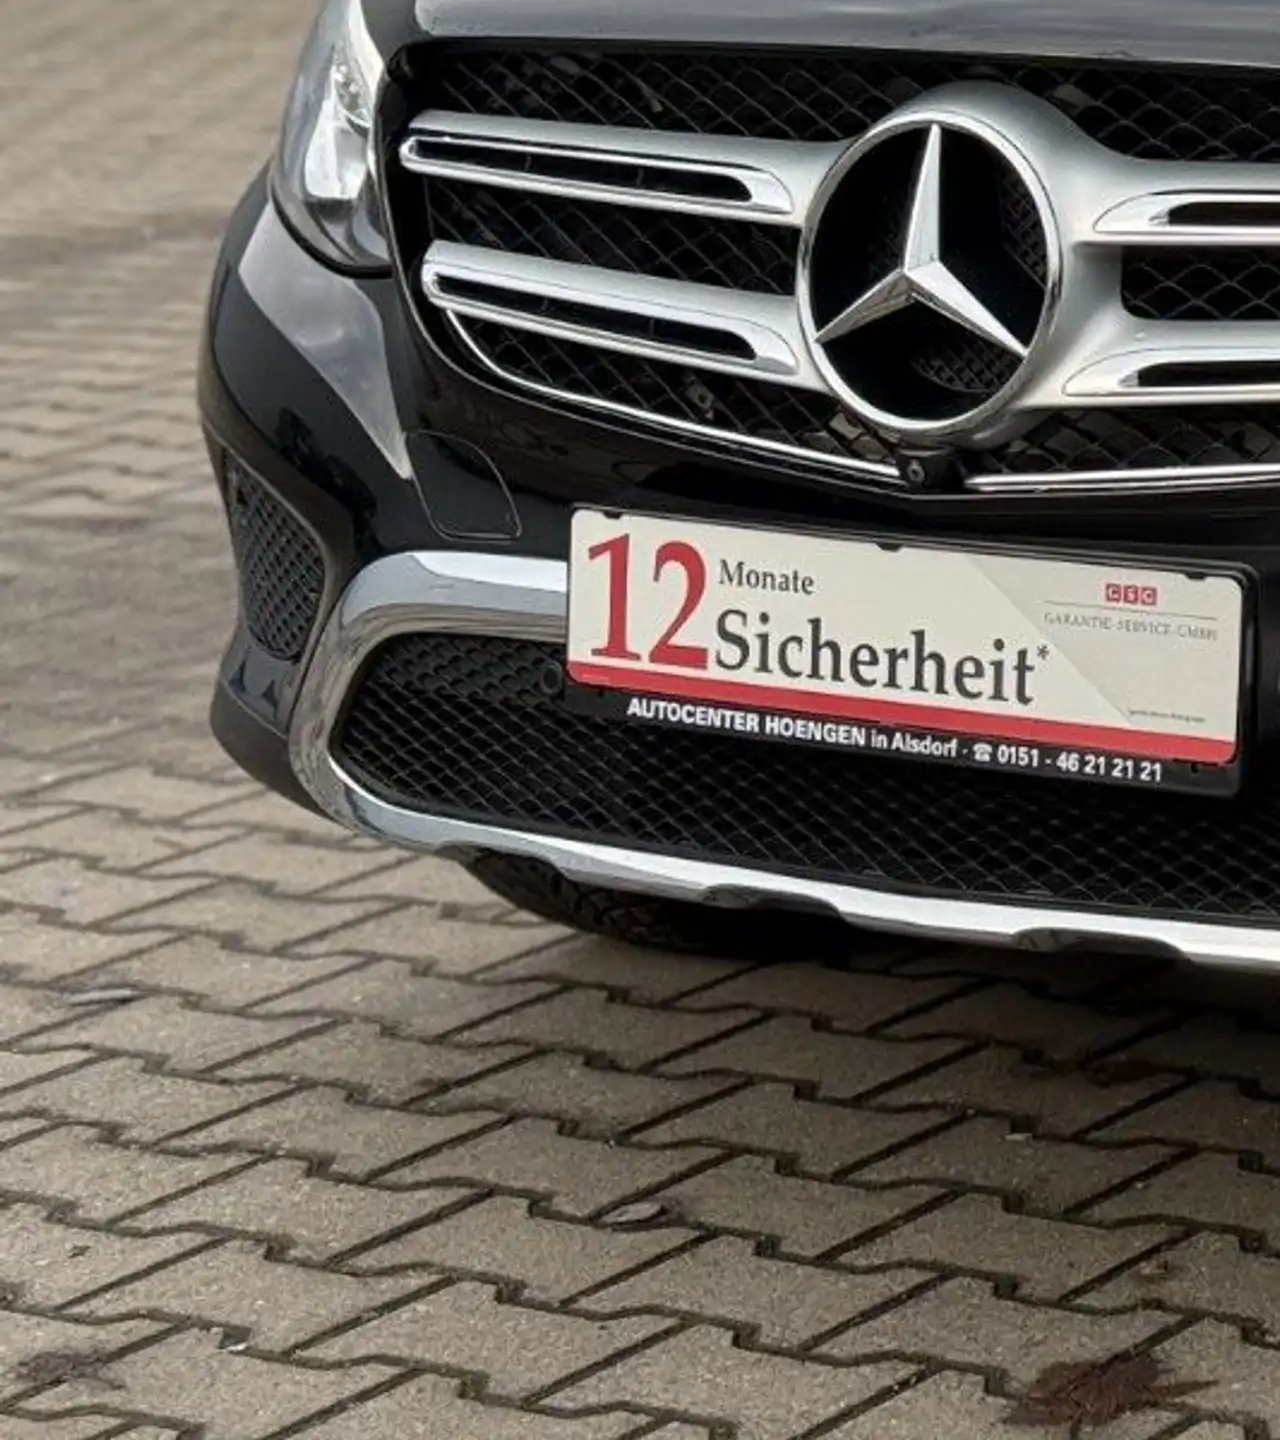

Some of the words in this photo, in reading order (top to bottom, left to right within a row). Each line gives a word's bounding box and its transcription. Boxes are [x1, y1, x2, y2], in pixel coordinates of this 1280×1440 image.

[588, 533, 708, 670] 12
[719, 559, 815, 595] Monate
[627, 697, 760, 733] AUTOCENTER
[765, 715, 866, 747] HOENGEN
[871, 728, 887, 750] in
[891, 732, 957, 758] Alsdorf
[997, 744, 1040, 767] 0151
[1056, 750, 1080, 773] 46
[1084, 753, 1106, 776] 21
[1111, 758, 1134, 779] 21
[1139, 762, 1162, 783] 21
